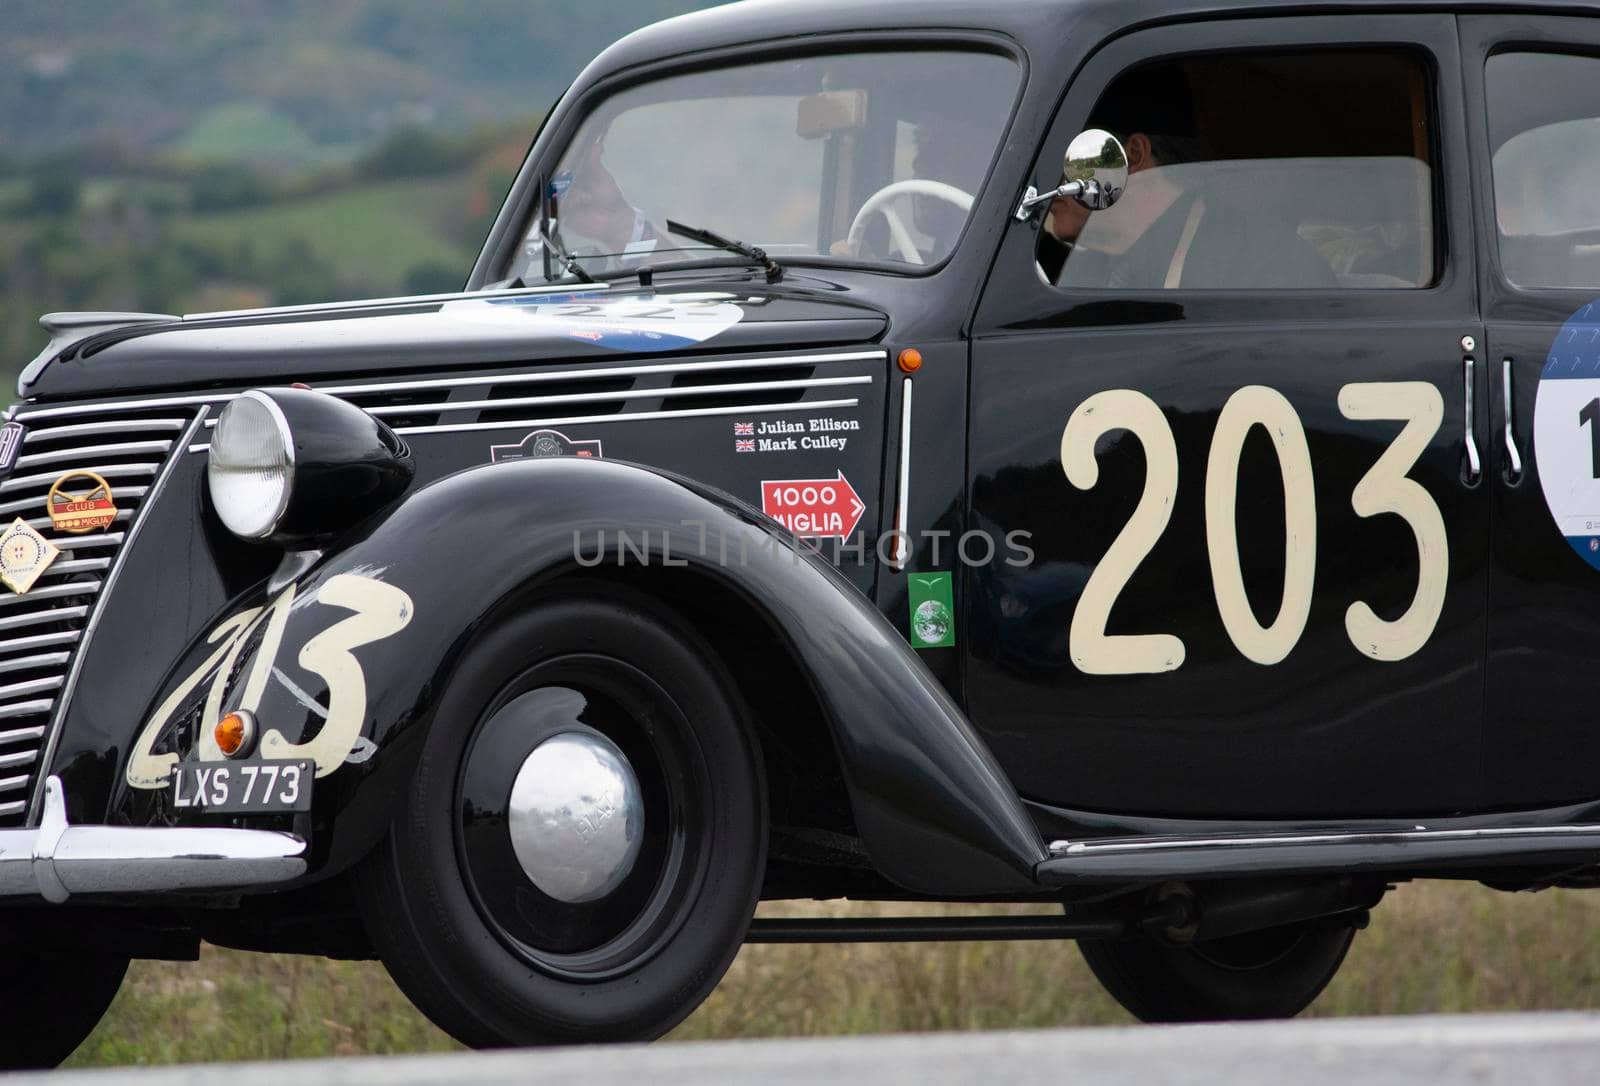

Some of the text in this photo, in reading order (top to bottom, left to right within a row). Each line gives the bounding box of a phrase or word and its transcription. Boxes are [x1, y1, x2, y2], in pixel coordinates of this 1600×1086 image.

[758, 418, 860, 434] Julian Ellison
[758, 435, 847, 452] Mark Culley
[773, 486, 836, 506] 1000
[66, 501, 95, 512] CLUB
[81, 516, 109, 526] MIGLIA
[1061, 381, 1449, 675] 203
[173, 765, 300, 808] LXS 773
